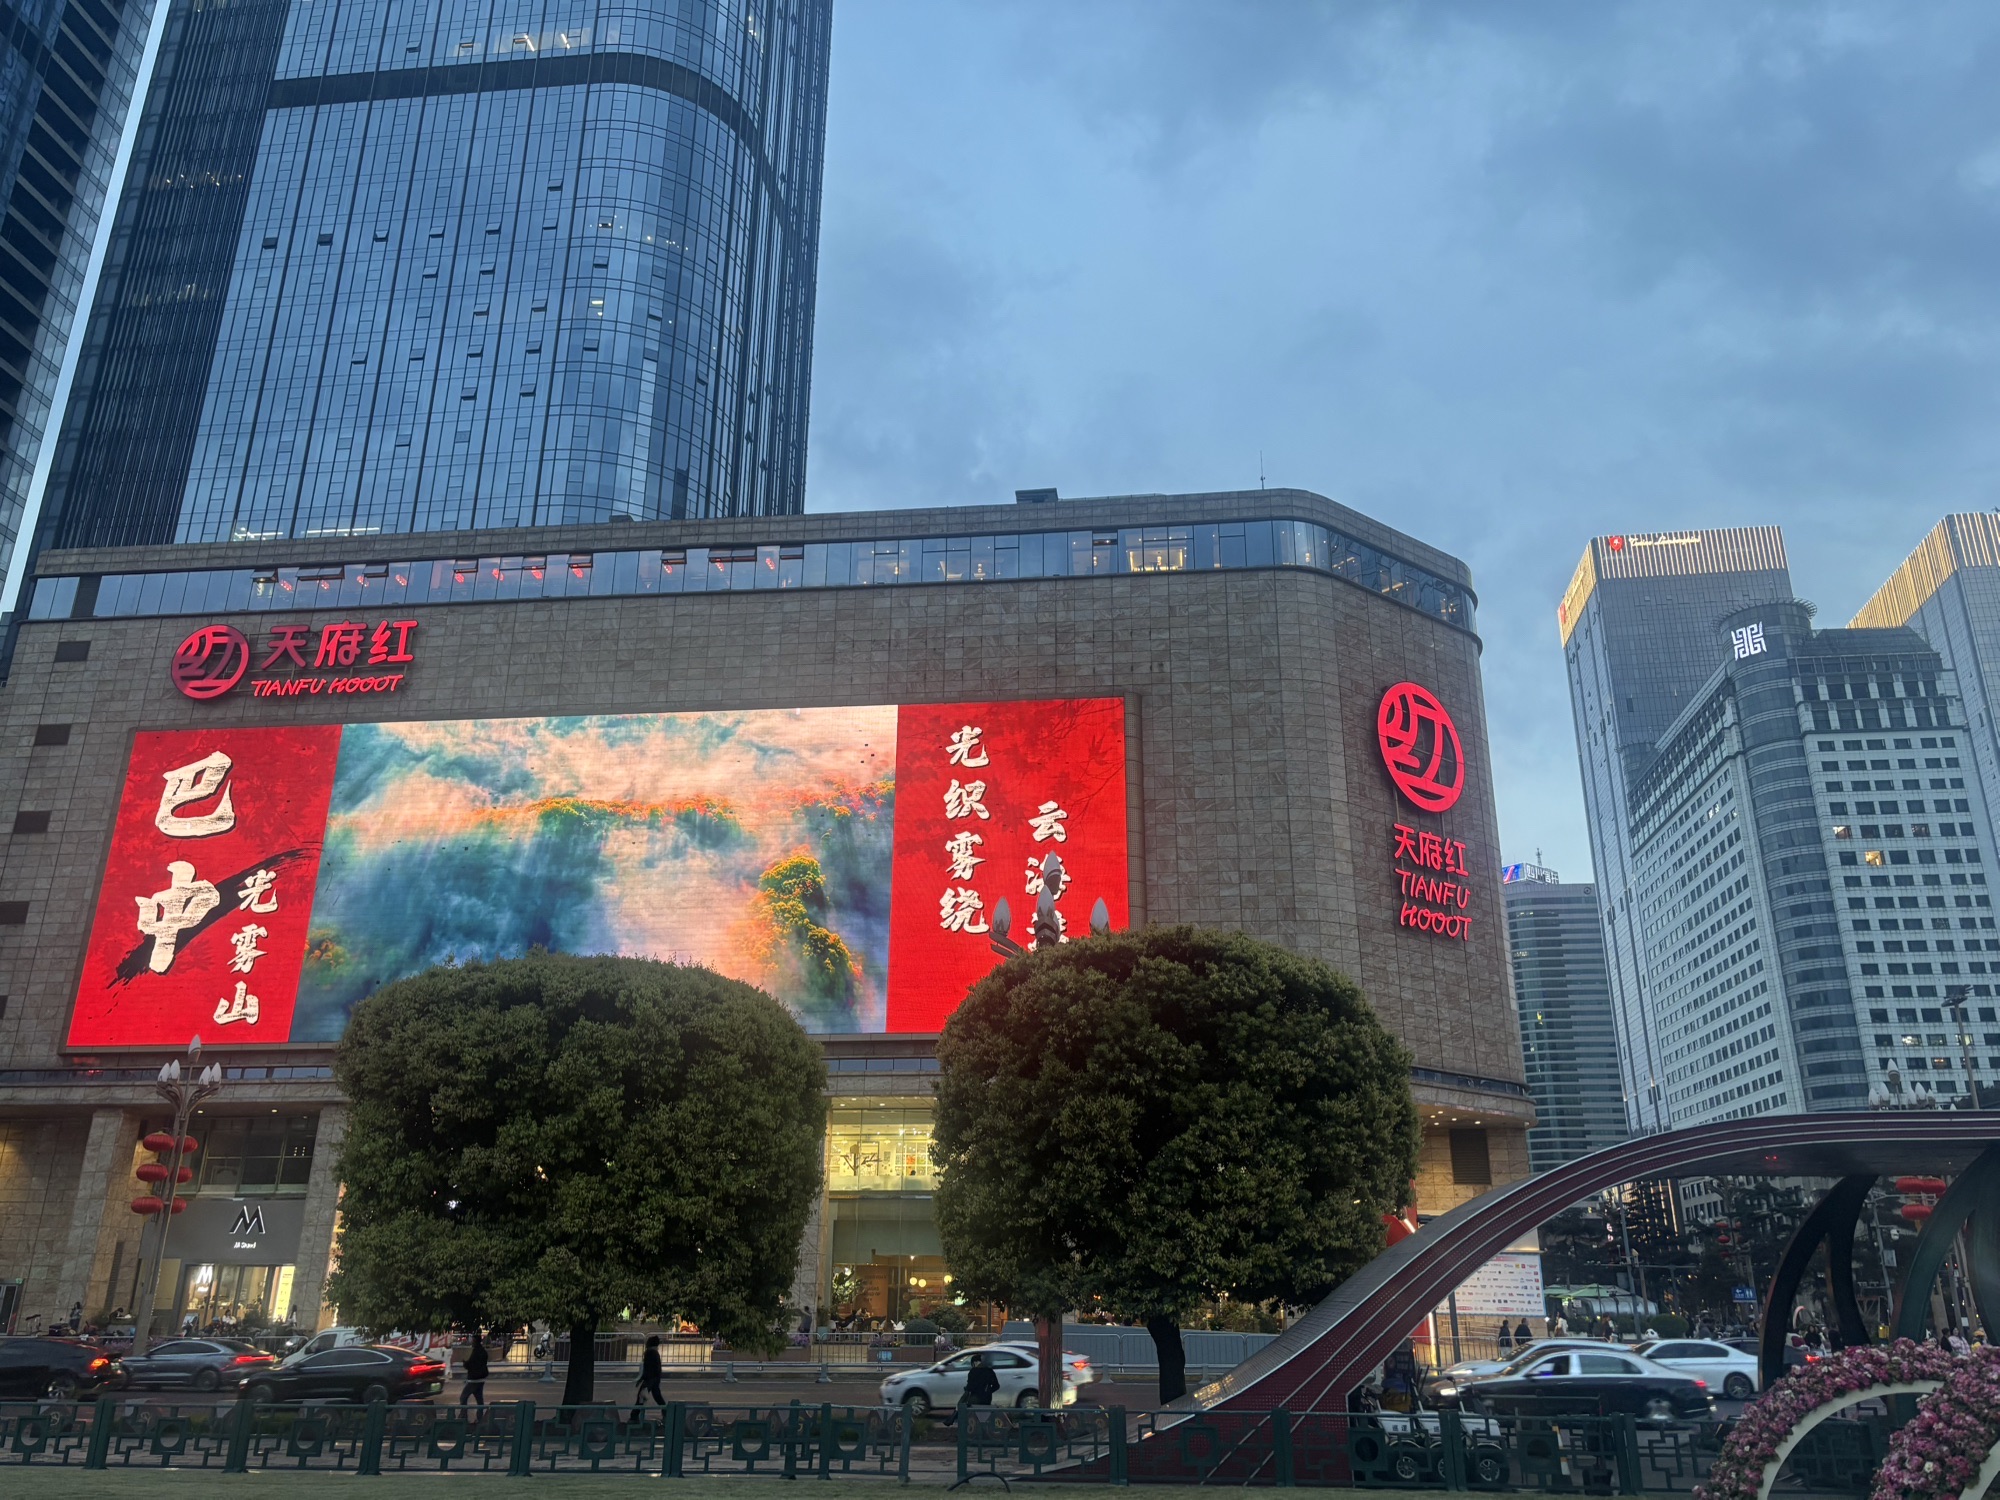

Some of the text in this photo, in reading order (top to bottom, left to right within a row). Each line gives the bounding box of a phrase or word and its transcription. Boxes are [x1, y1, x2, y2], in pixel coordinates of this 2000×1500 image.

[261, 619, 419, 670] 天府红
[251, 677, 327, 697] TIANFU
[939, 725, 991, 934] 光织雾绕
[1394, 823, 1469, 877] 天府红
[135, 750, 236, 974] 巴中
[1395, 868, 1471, 909] TIANFU
[213, 869, 279, 1025] 光雾山
